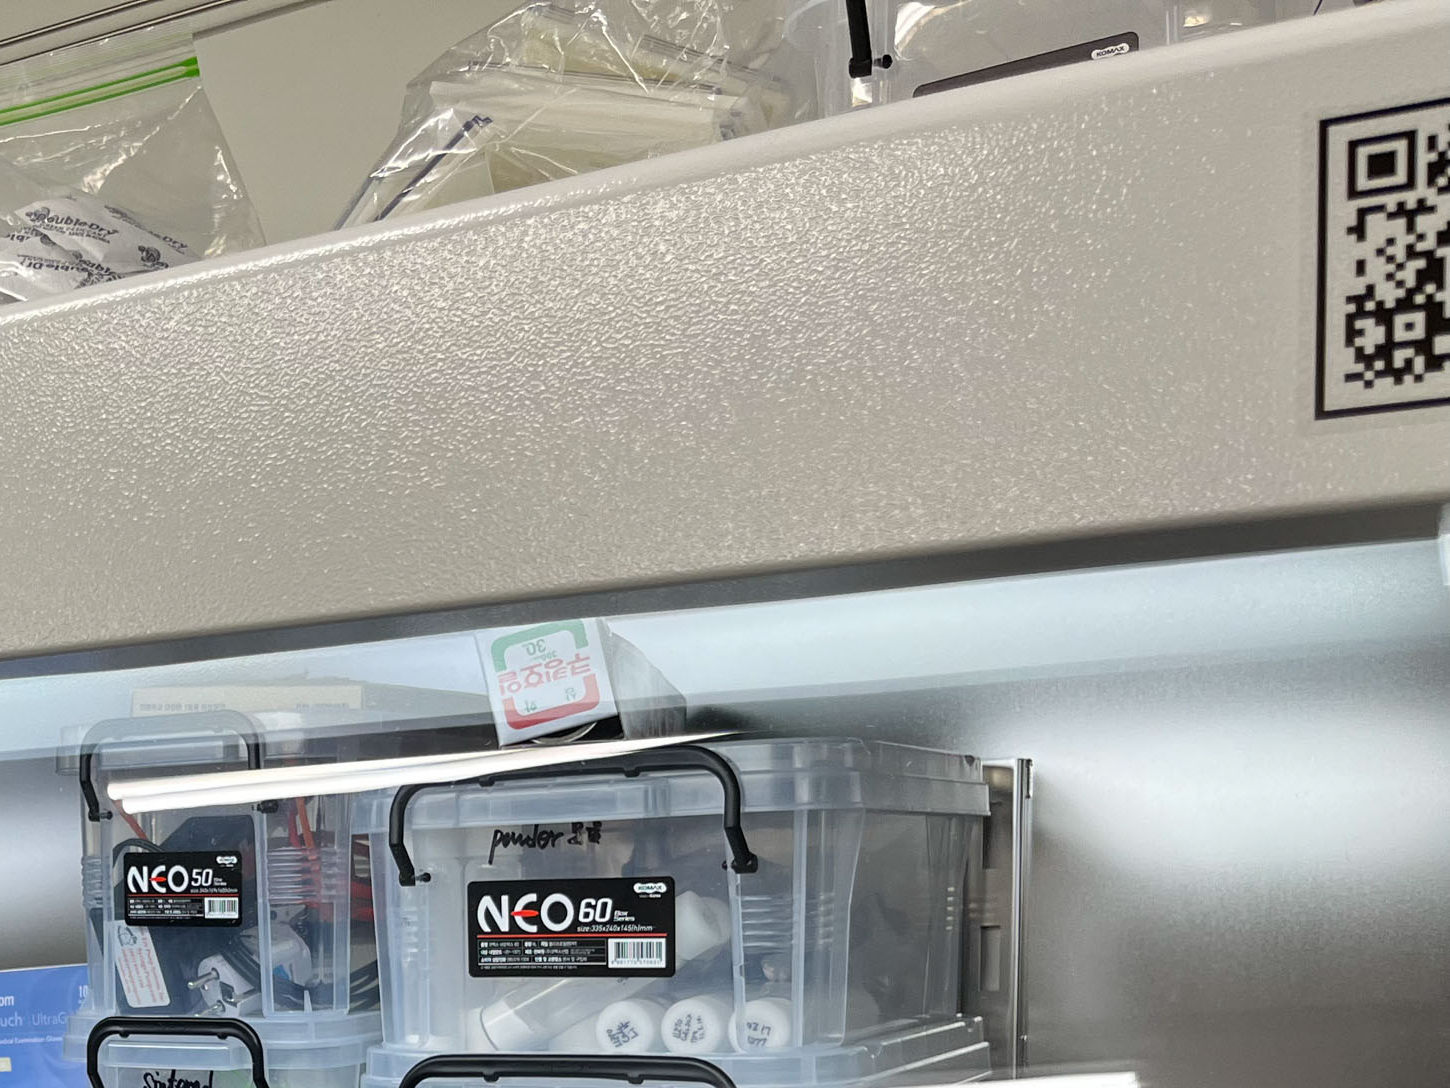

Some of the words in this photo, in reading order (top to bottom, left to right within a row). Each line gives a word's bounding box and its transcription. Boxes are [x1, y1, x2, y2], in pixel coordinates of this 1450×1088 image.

[497, 653, 591, 697] 쿠킹호일
[127, 865, 189, 894] NEO
[191, 868, 213, 887] 50
[477, 893, 574, 933] NEO
[578, 898, 613, 923] 60
